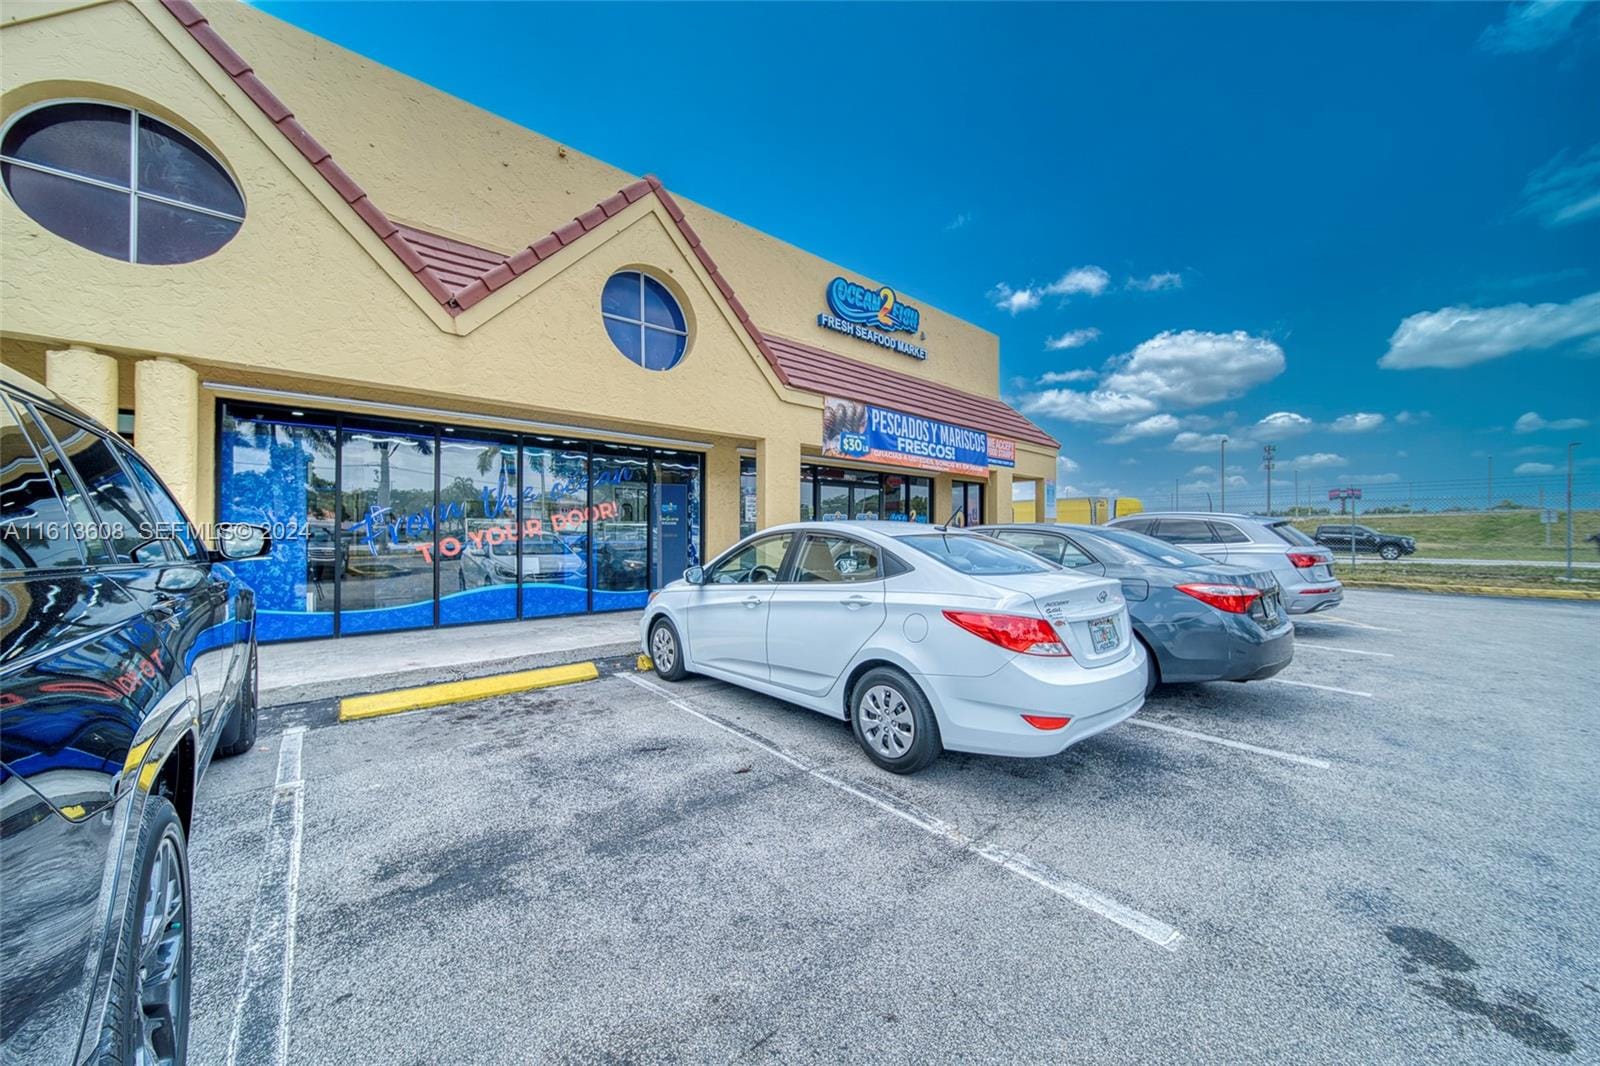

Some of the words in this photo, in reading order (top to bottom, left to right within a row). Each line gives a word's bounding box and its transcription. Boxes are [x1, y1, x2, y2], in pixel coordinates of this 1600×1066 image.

[828, 277, 880, 313] OCEAN
[877, 287, 895, 326] 2
[892, 302, 919, 331] FISH
[820, 313, 854, 334] FRESH
[855, 325, 896, 350] SEAFOOD
[896, 339, 929, 360] MARKET
[871, 408, 929, 442] PESCADOS
[930, 422, 938, 442] Y
[940, 424, 985, 453] MARISCOS
[897, 437, 956, 460] FRESCOS!
[482, 462, 539, 518] the
[416, 536, 461, 564] TO
[468, 518, 542, 549] YOUR
[551, 502, 618, 532] DOOR!
